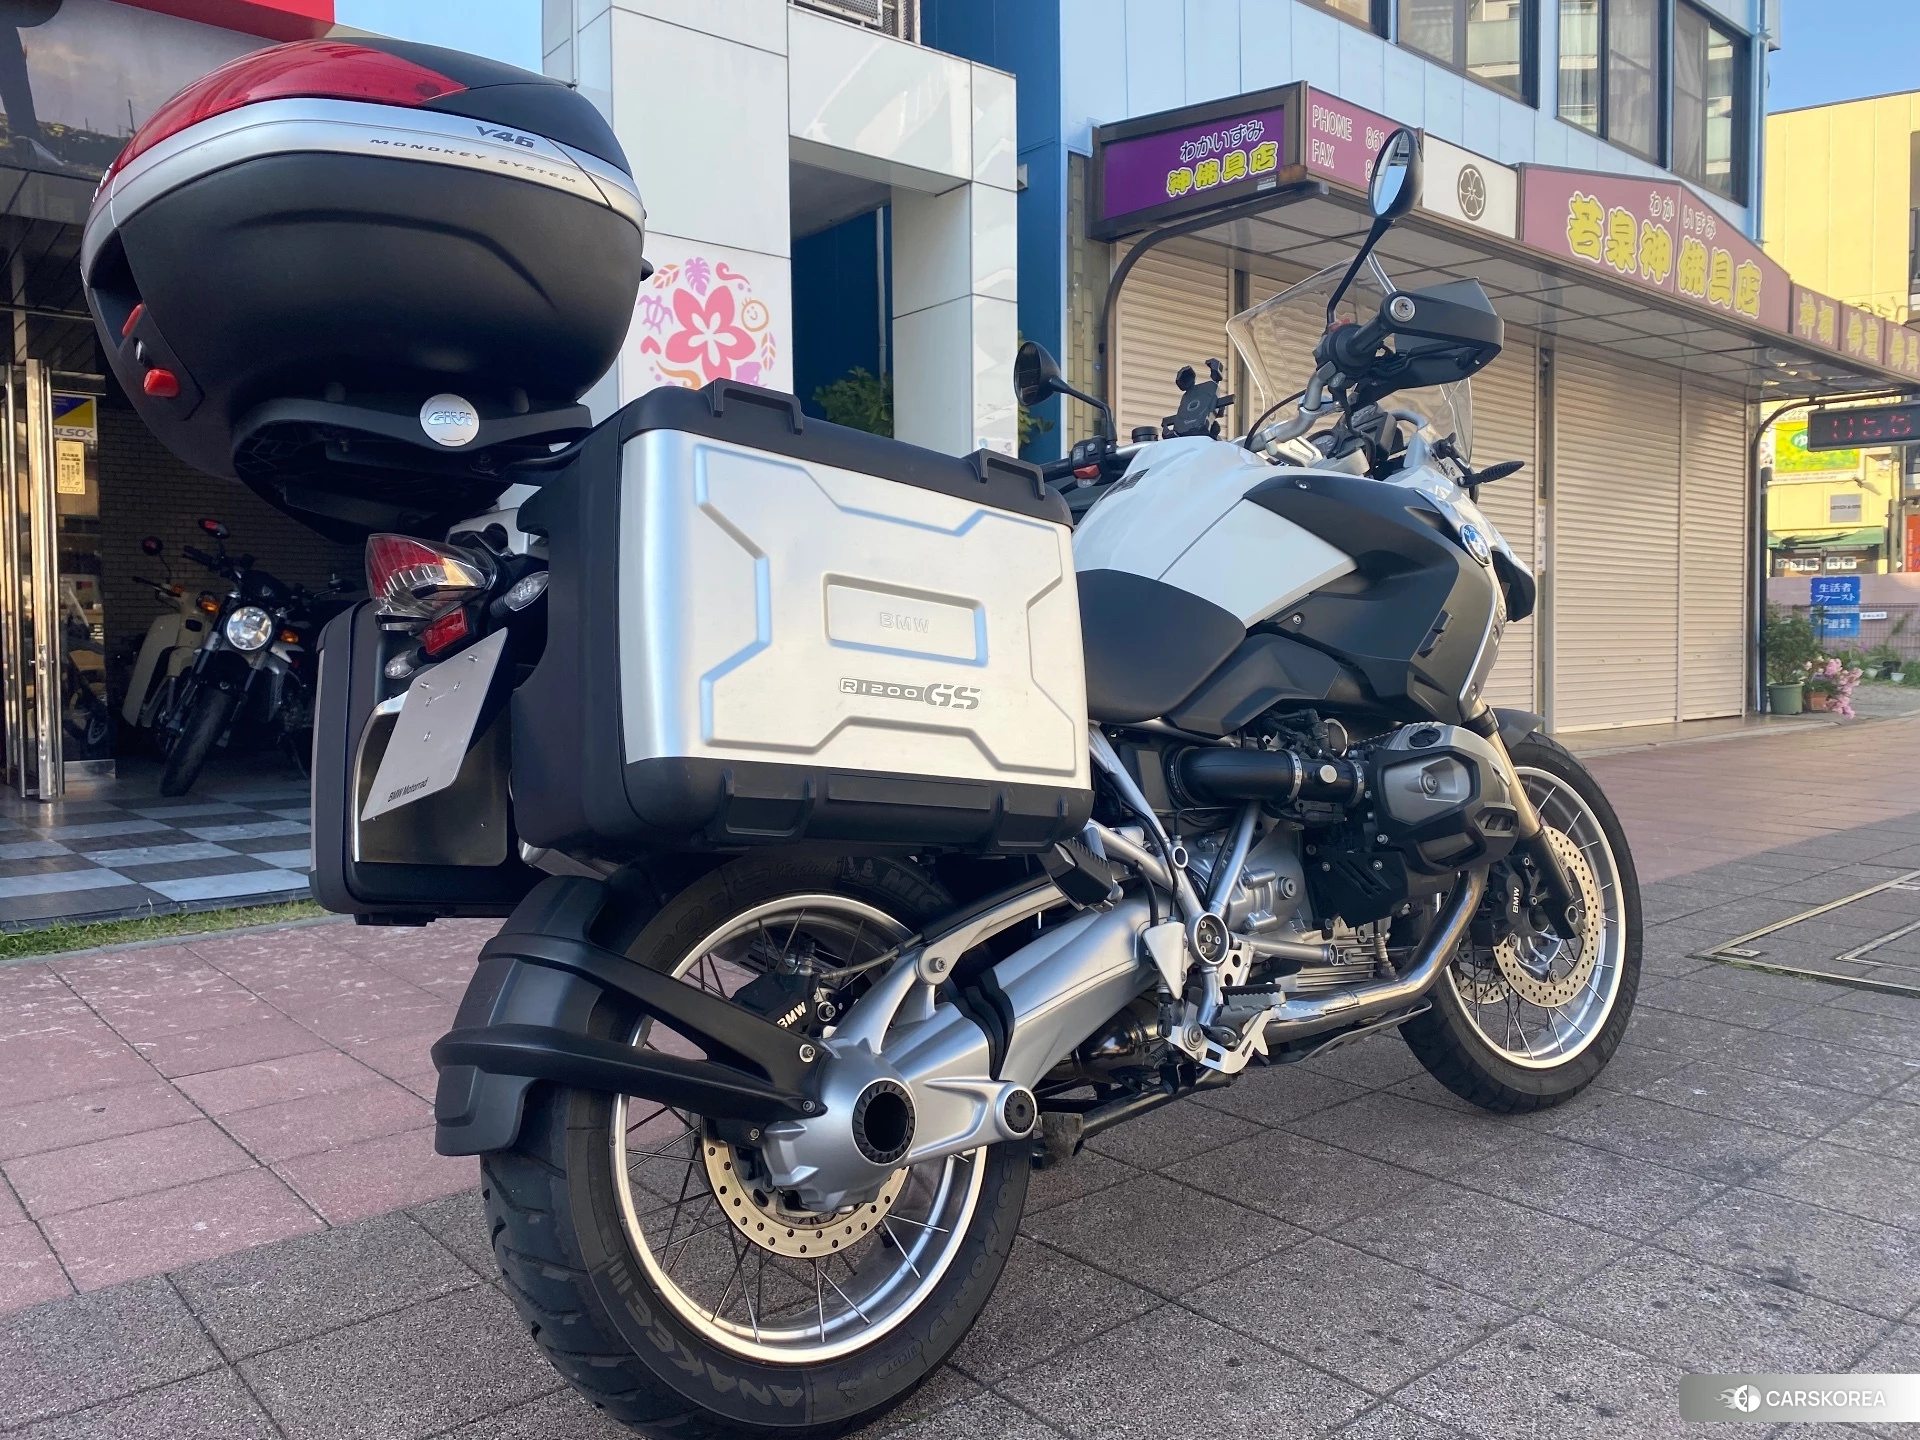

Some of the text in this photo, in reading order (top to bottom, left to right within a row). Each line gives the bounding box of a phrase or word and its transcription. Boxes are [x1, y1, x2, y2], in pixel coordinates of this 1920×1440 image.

[1312, 104, 1353, 142] PHONE
[476, 125, 535, 149] V46
[1180, 120, 1265, 162] わかいずみ
[369, 138, 577, 183] MONOKEY SYSTEM
[1312, 138, 1335, 169] FAX
[428, 410, 473, 426] GIVI
[1815, 593, 1855, 602] ファースト
[1819, 583, 1852, 593] 生活者
[879, 612, 929, 633] BMW
[387, 777, 429, 802] BMW Motorrad
[1512, 887, 1521, 913] BMW
[625, 1300, 804, 1407] ANAKEE
